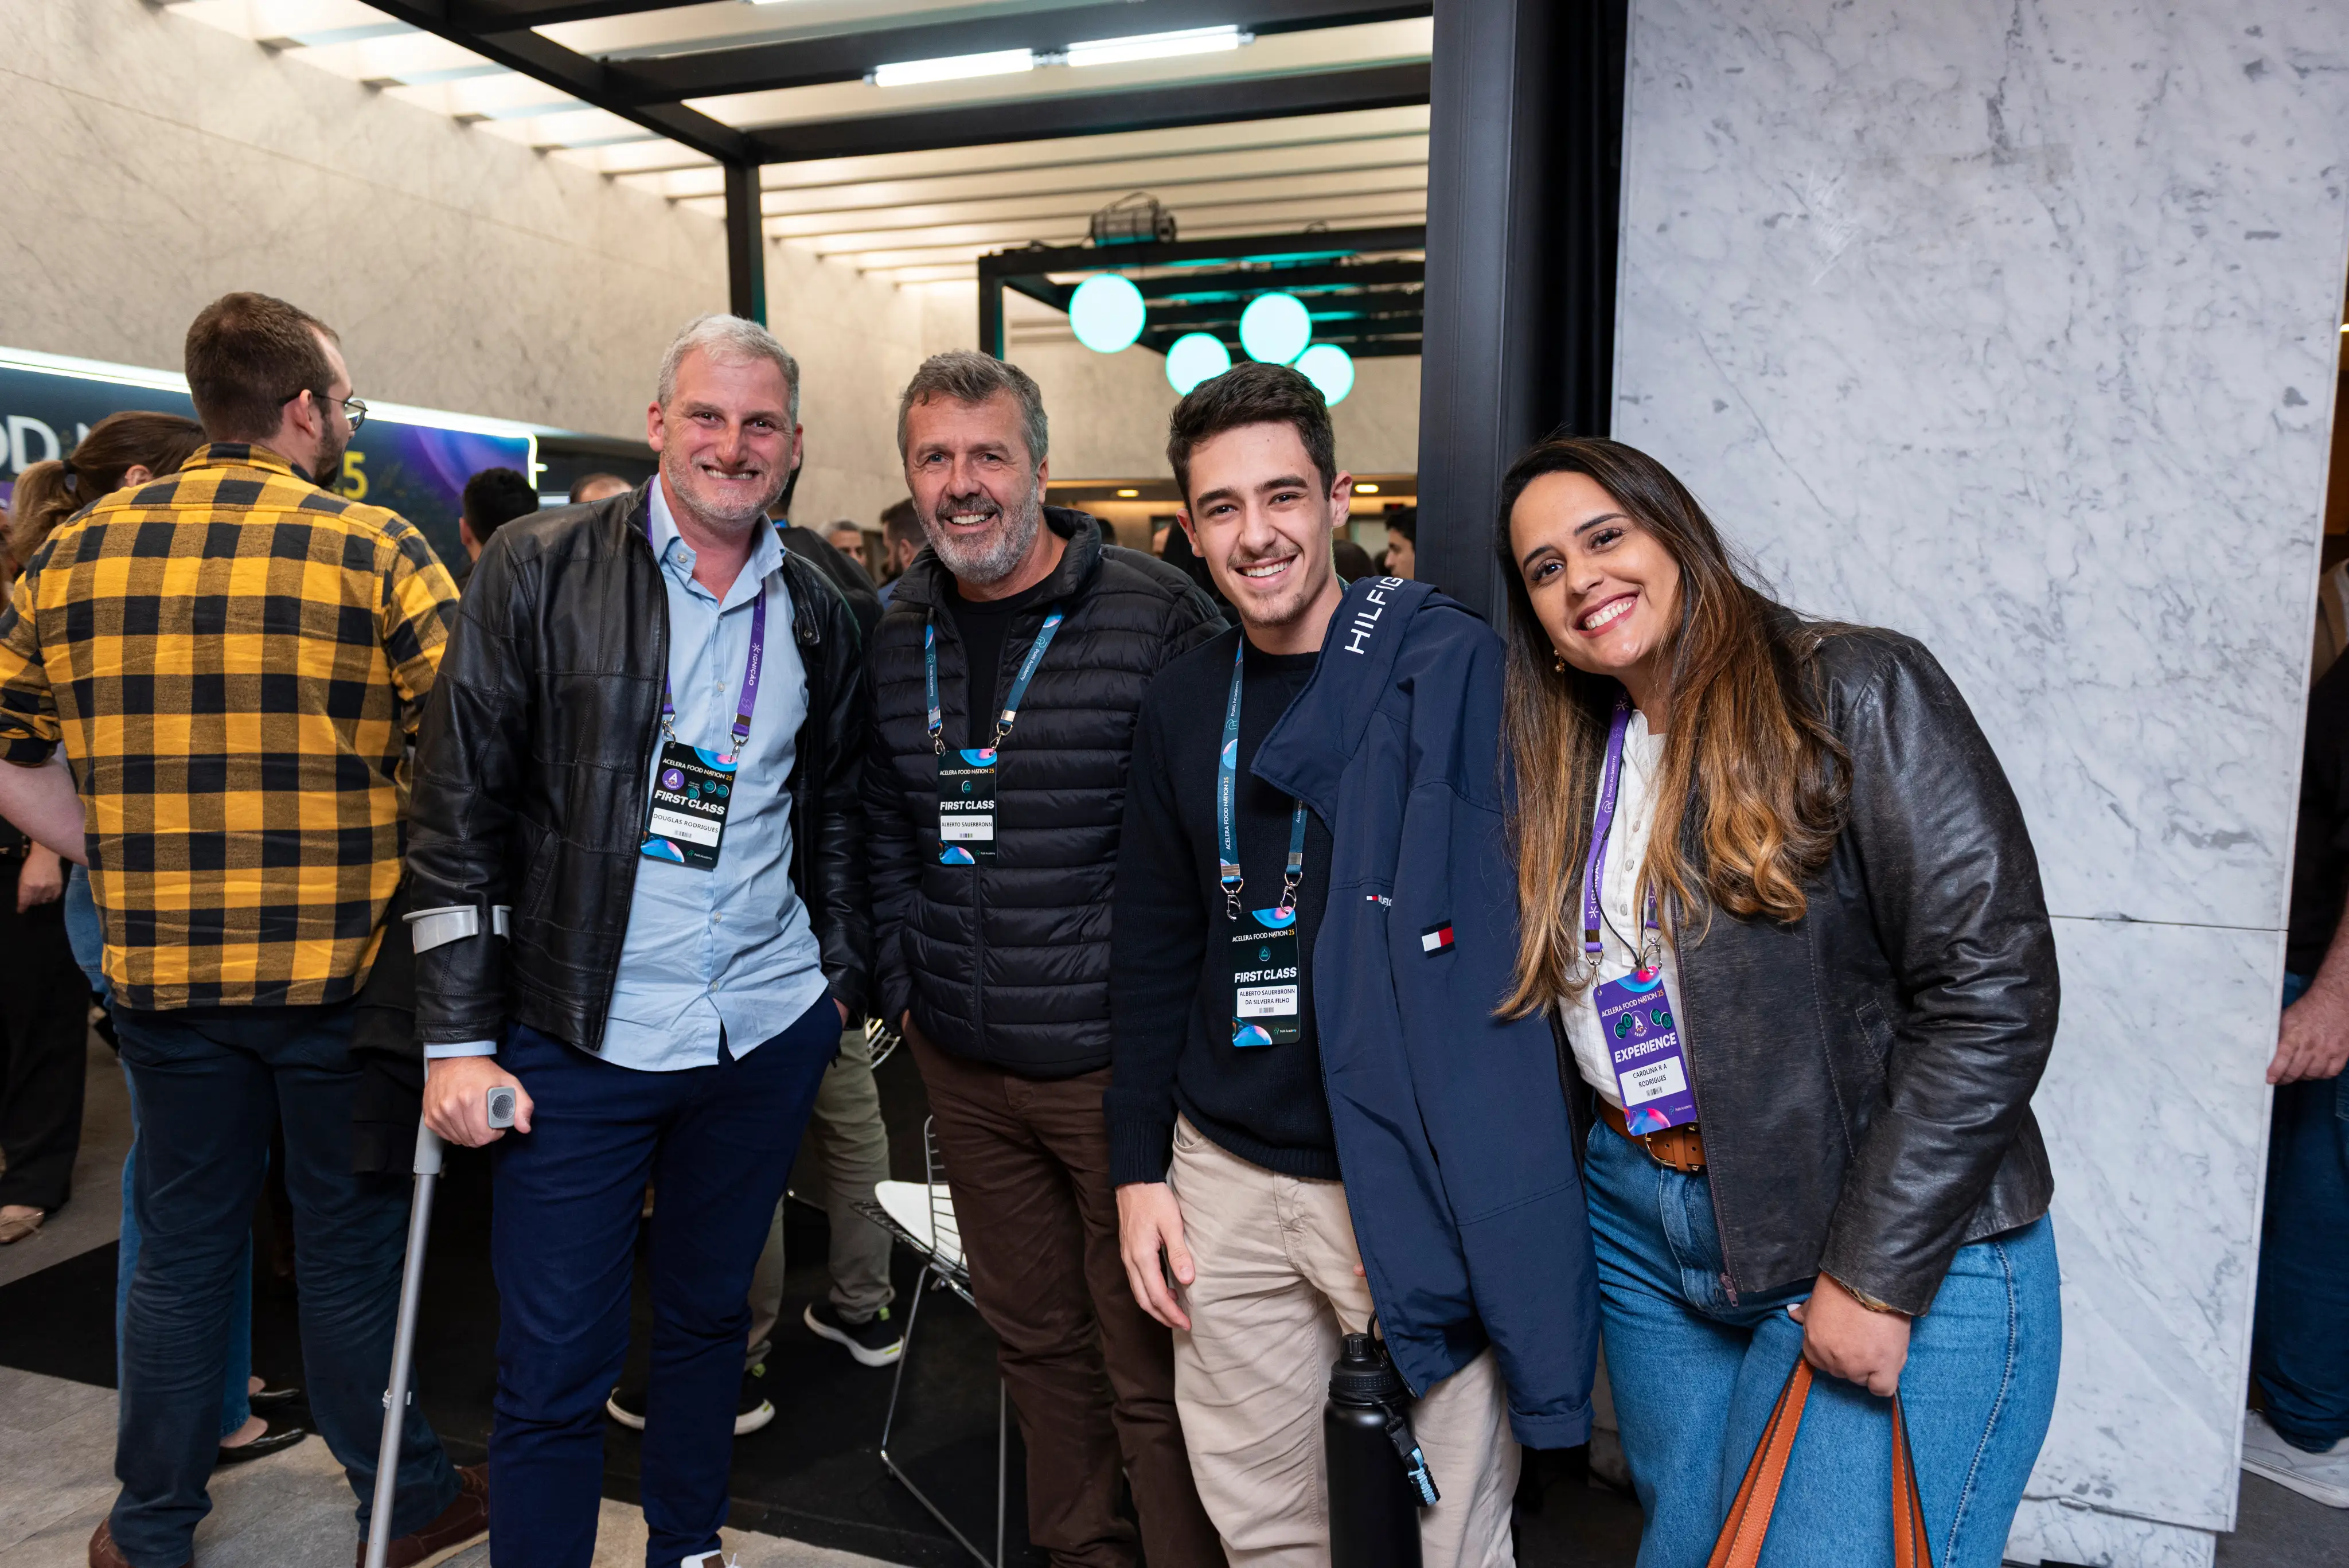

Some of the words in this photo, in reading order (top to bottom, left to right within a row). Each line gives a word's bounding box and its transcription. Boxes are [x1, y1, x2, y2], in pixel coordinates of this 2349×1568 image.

[0, 415, 61, 475] D
[748, 653, 758, 686] IGNIÇÃO
[1020, 660, 1033, 681] Academy
[662, 758, 686, 769] ACELERA
[687, 765, 703, 773] FOOD
[704, 770, 725, 779] NATION
[654, 789, 688, 805] FIRST
[688, 799, 725, 815] CLASS
[940, 801, 965, 810] FIRST
[965, 800, 994, 810] CLASS
[653, 813, 682, 825] DOUGLAS
[684, 821, 719, 833] RODRIGUES
[1232, 934, 1252, 942] ACELERA
[1269, 930, 1287, 938] NATION
[1234, 970, 1263, 983] FIRST
[1263, 966, 1297, 980] CLASS
[1602, 1005, 1622, 1017] ACELERA
[1622, 999, 1637, 1009] FOOD
[1637, 992, 1657, 1004] NATION
[1657, 989, 1664, 997] 25
[1614, 1032, 1677, 1063] EXPERIENCE
[1633, 1066, 1658, 1079] CAROLINA
[1638, 1075, 1667, 1088] RODRIGUES
